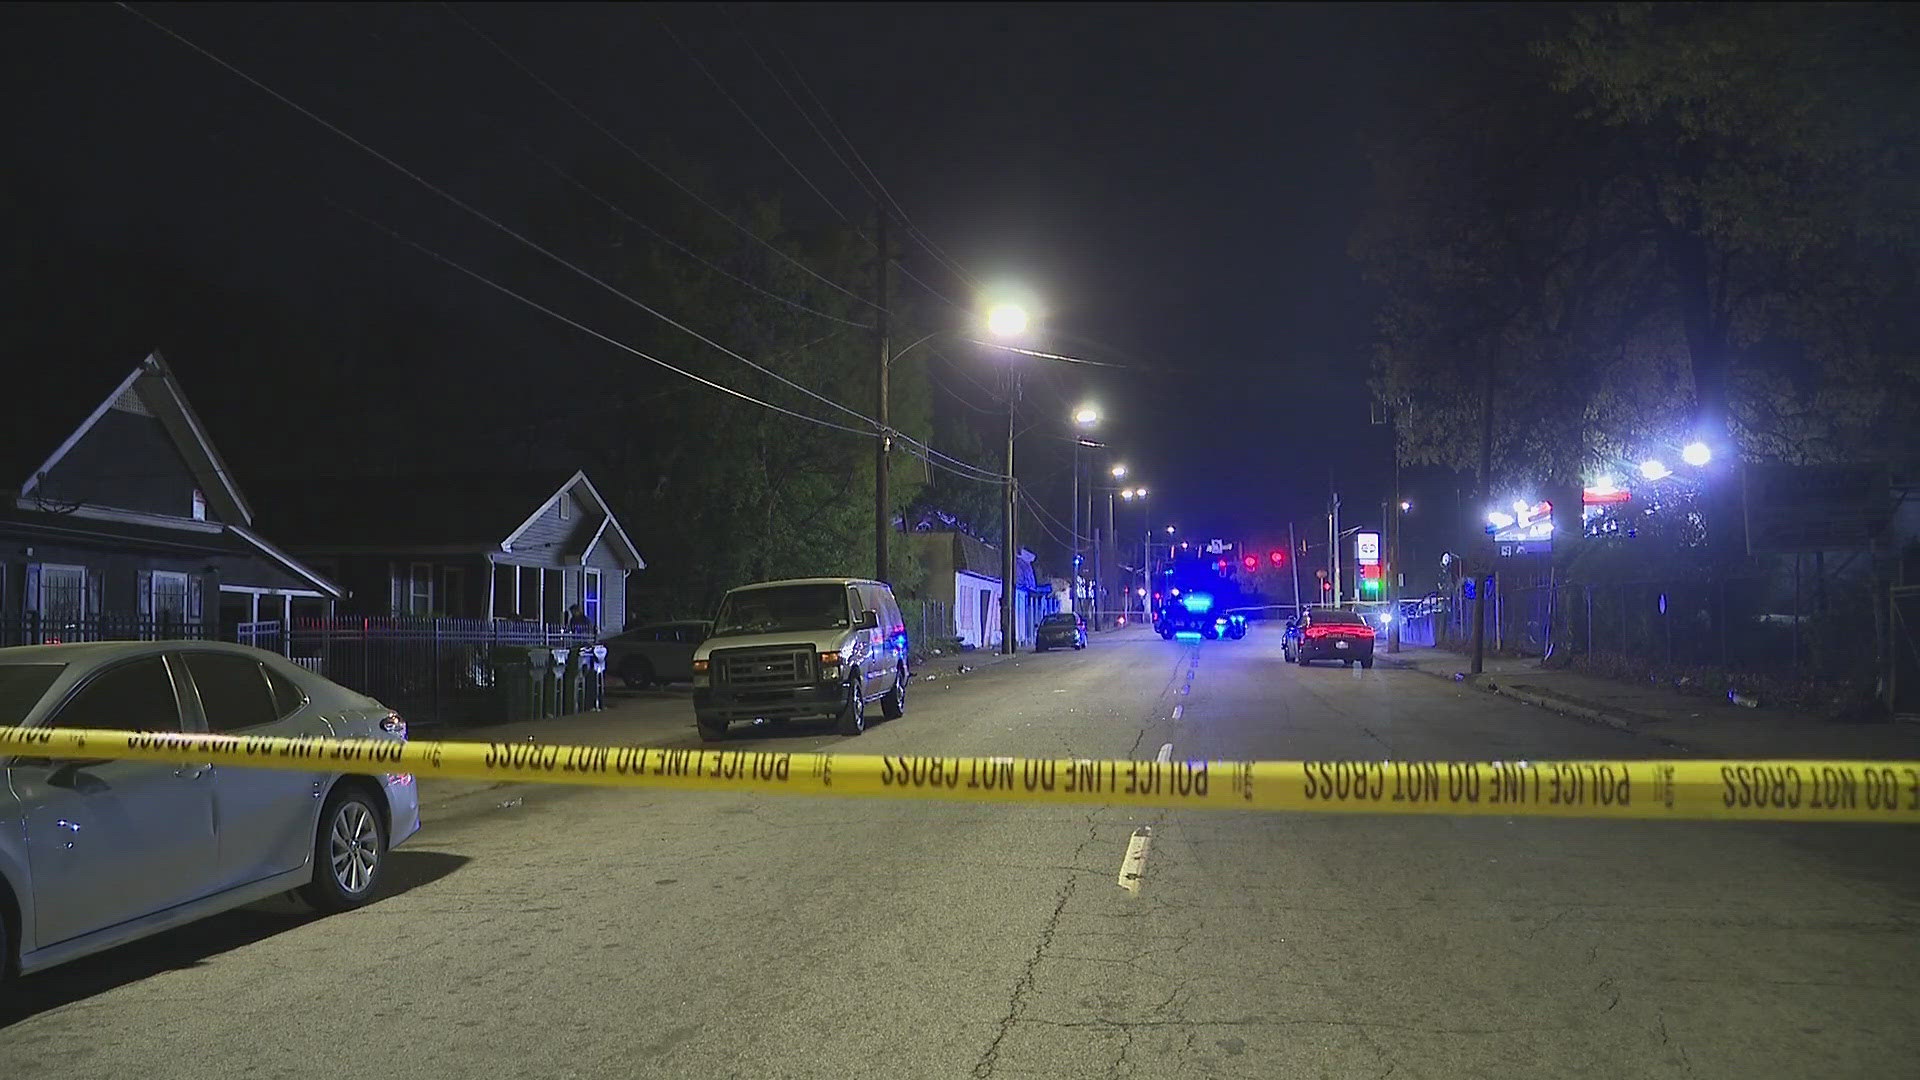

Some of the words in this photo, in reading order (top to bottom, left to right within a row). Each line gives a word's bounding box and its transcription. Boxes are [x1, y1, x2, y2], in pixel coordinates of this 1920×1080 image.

[485, 743, 559, 771] CROSS
[563, 746, 608, 772] NOT
[617, 748, 648, 775] DO
[654, 750, 704, 776] LINE
[711, 751, 791, 781] POLICE
[882, 756, 959, 788] CROSS
[968, 757, 1014, 790] NOT
[1024, 759, 1055, 791] DO
[1065, 760, 1116, 793] LINE
[1126, 762, 1208, 796] POLICE
[1304, 761, 1384, 800] CROSS
[1393, 762, 1439, 801] NOT
[1449, 763, 1479, 802] DO
[1490, 762, 1540, 804] LINE
[1550, 764, 1630, 805] POLICE
[1721, 766, 1801, 808] CROSS
[1810, 766, 1857, 809] NOT
[1865, 768, 1899, 810] DO
